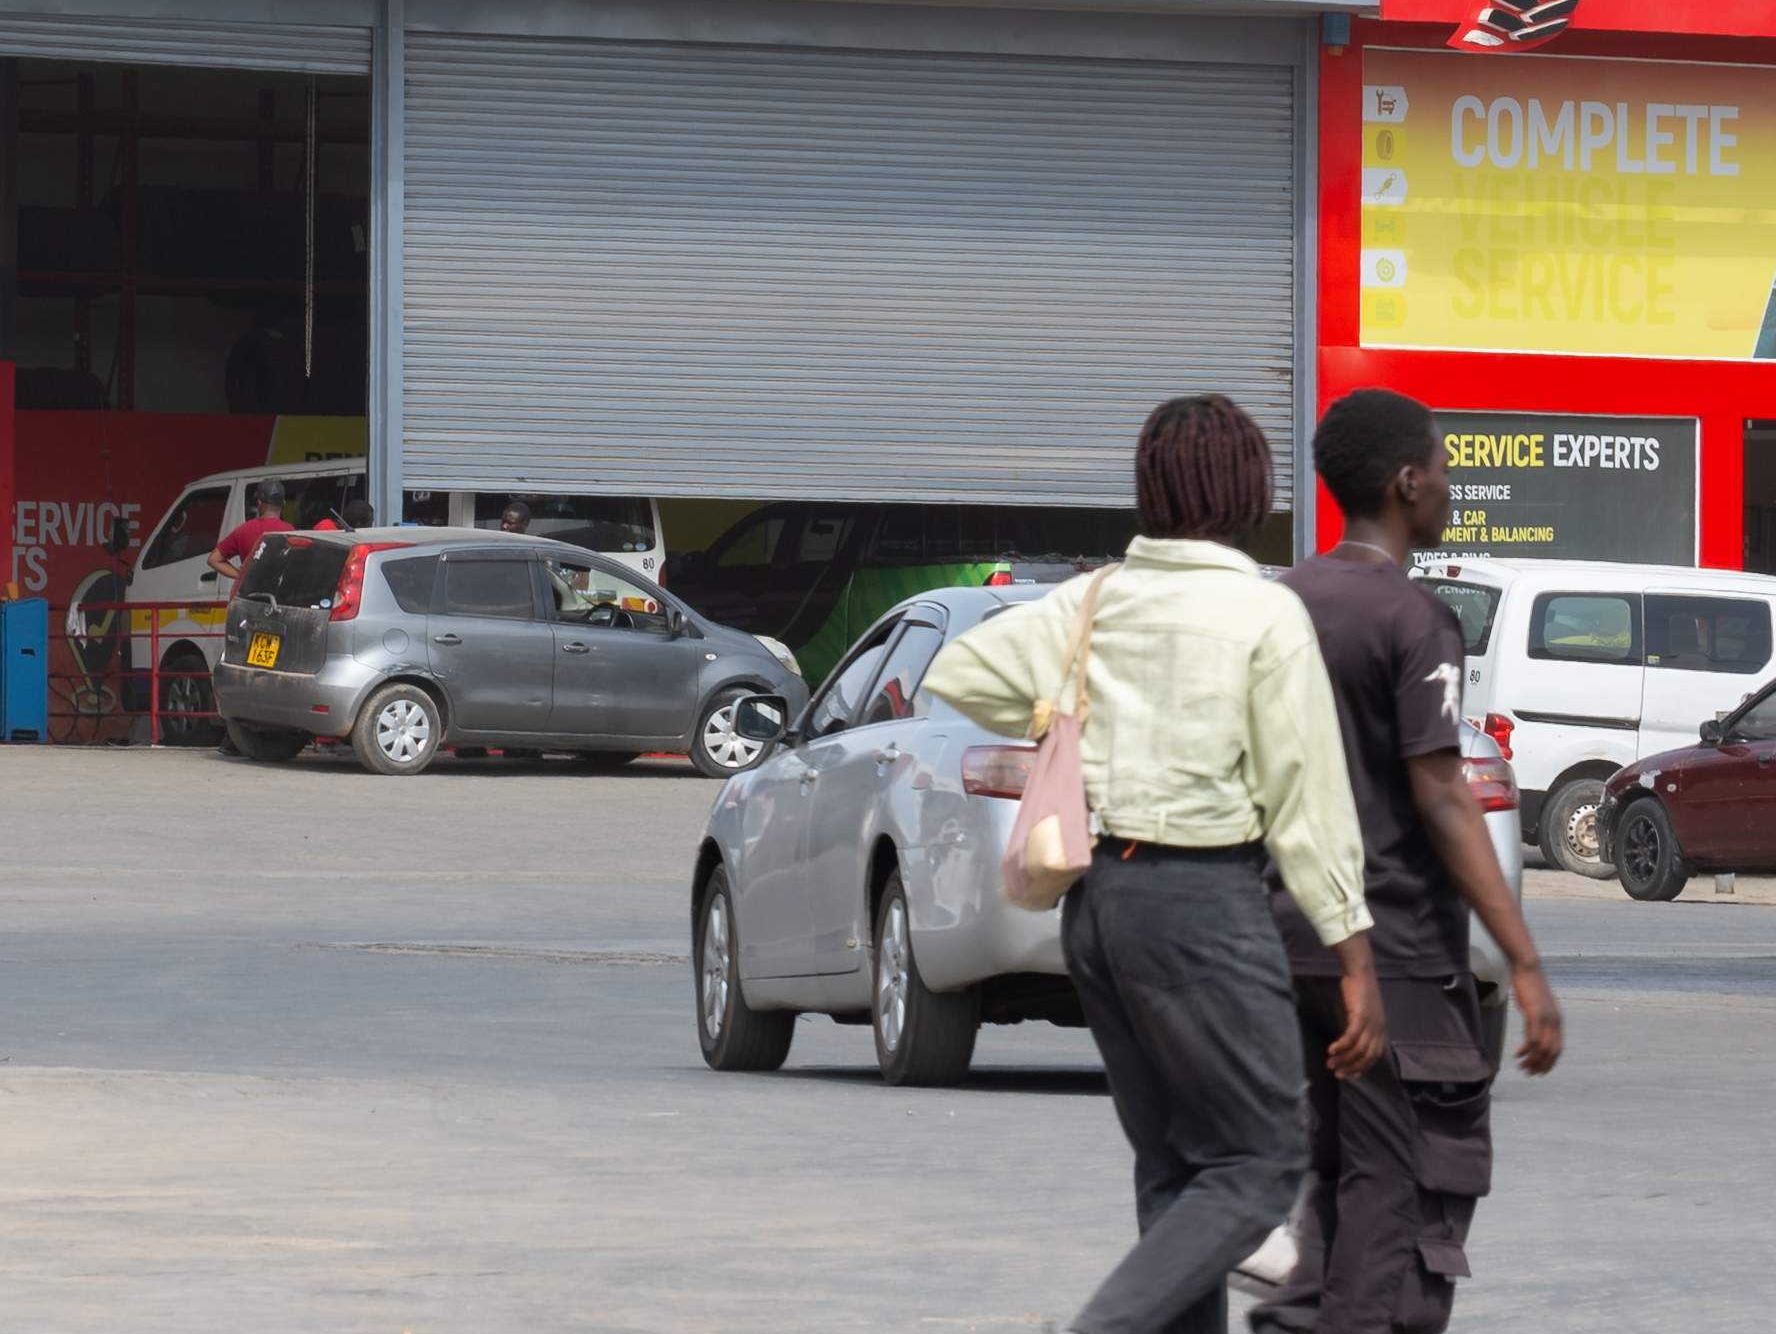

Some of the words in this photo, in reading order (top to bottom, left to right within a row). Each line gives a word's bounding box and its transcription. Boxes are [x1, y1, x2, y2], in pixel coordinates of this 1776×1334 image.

[1450, 95, 1739, 177] COMPLETE
[1451, 173, 1677, 248] VEHICLE
[1450, 247, 1676, 325] SERVICE
[1444, 434, 1544, 468] SERVICE
[1553, 434, 1660, 471] EXPERTS
[1464, 484, 1511, 501] SERVICE
[13, 501, 142, 548] ERVICE
[1452, 510, 1462, 525] &
[1463, 510, 1486, 525] CAR
[1479, 527, 1489, 543] &
[1491, 526, 1554, 543] BALANCING
[642, 557, 655, 570] 80
[1469, 669, 1481, 683] 80
